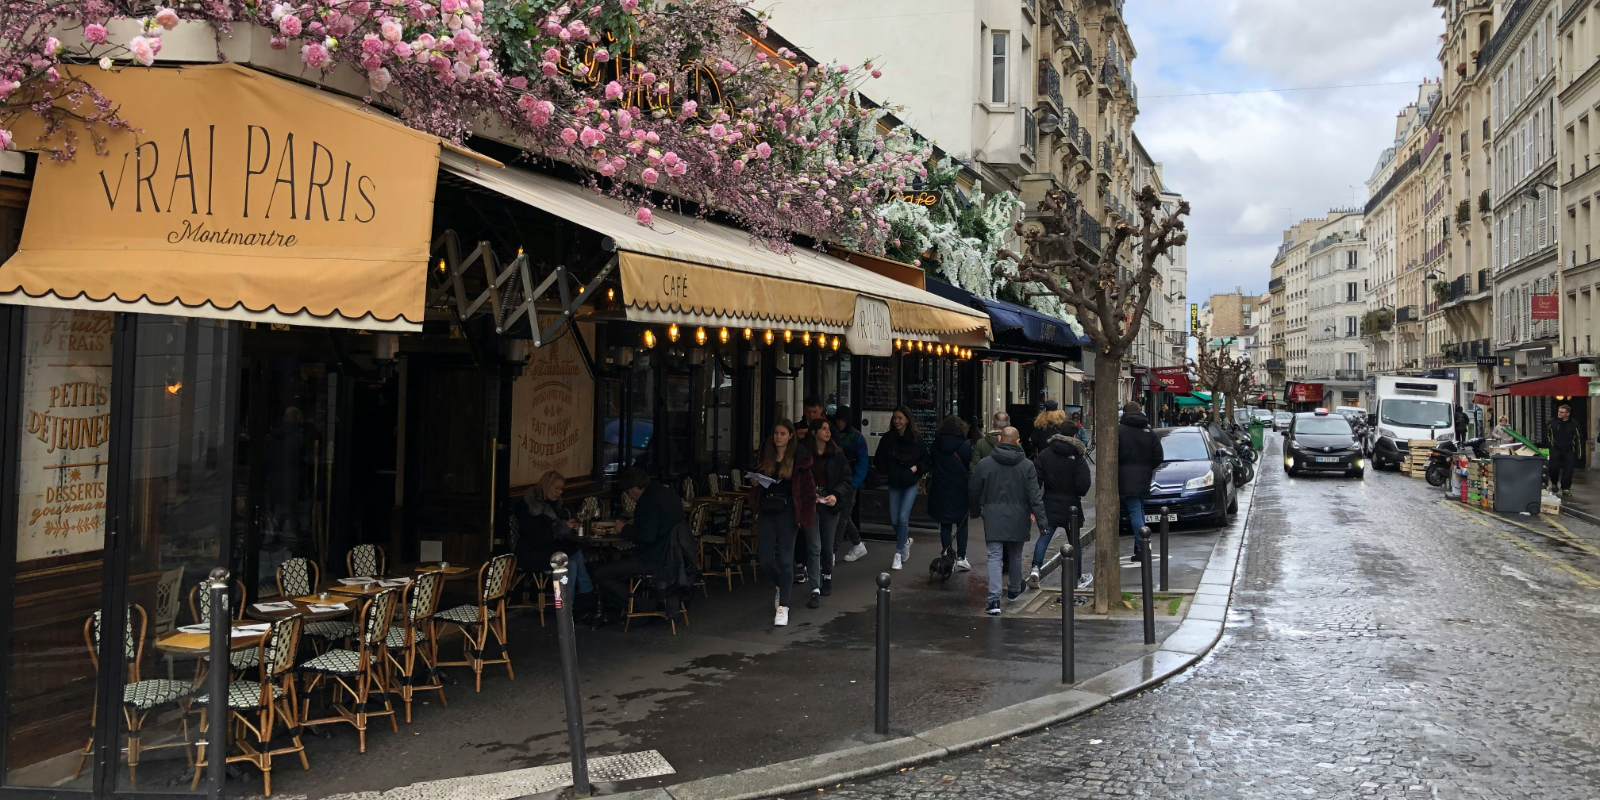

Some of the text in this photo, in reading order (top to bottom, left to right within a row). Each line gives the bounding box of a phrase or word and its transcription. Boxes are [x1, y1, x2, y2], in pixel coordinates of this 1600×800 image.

[99, 124, 377, 224] VRAI PARIS
[166, 219, 299, 248] Montmartre
[662, 273, 688, 298] CAFÉ
[43, 309, 115, 346] fruits
[57, 334, 105, 352] FRAIS
[48, 381, 108, 408] PETITS
[532, 389, 558, 409] PRODUITS
[531, 415, 572, 437] FAIT MAISON
[529, 438, 555, 456] TOUTE
[555, 429, 580, 454] HEURE
[45, 481, 105, 504] DESSERTS
